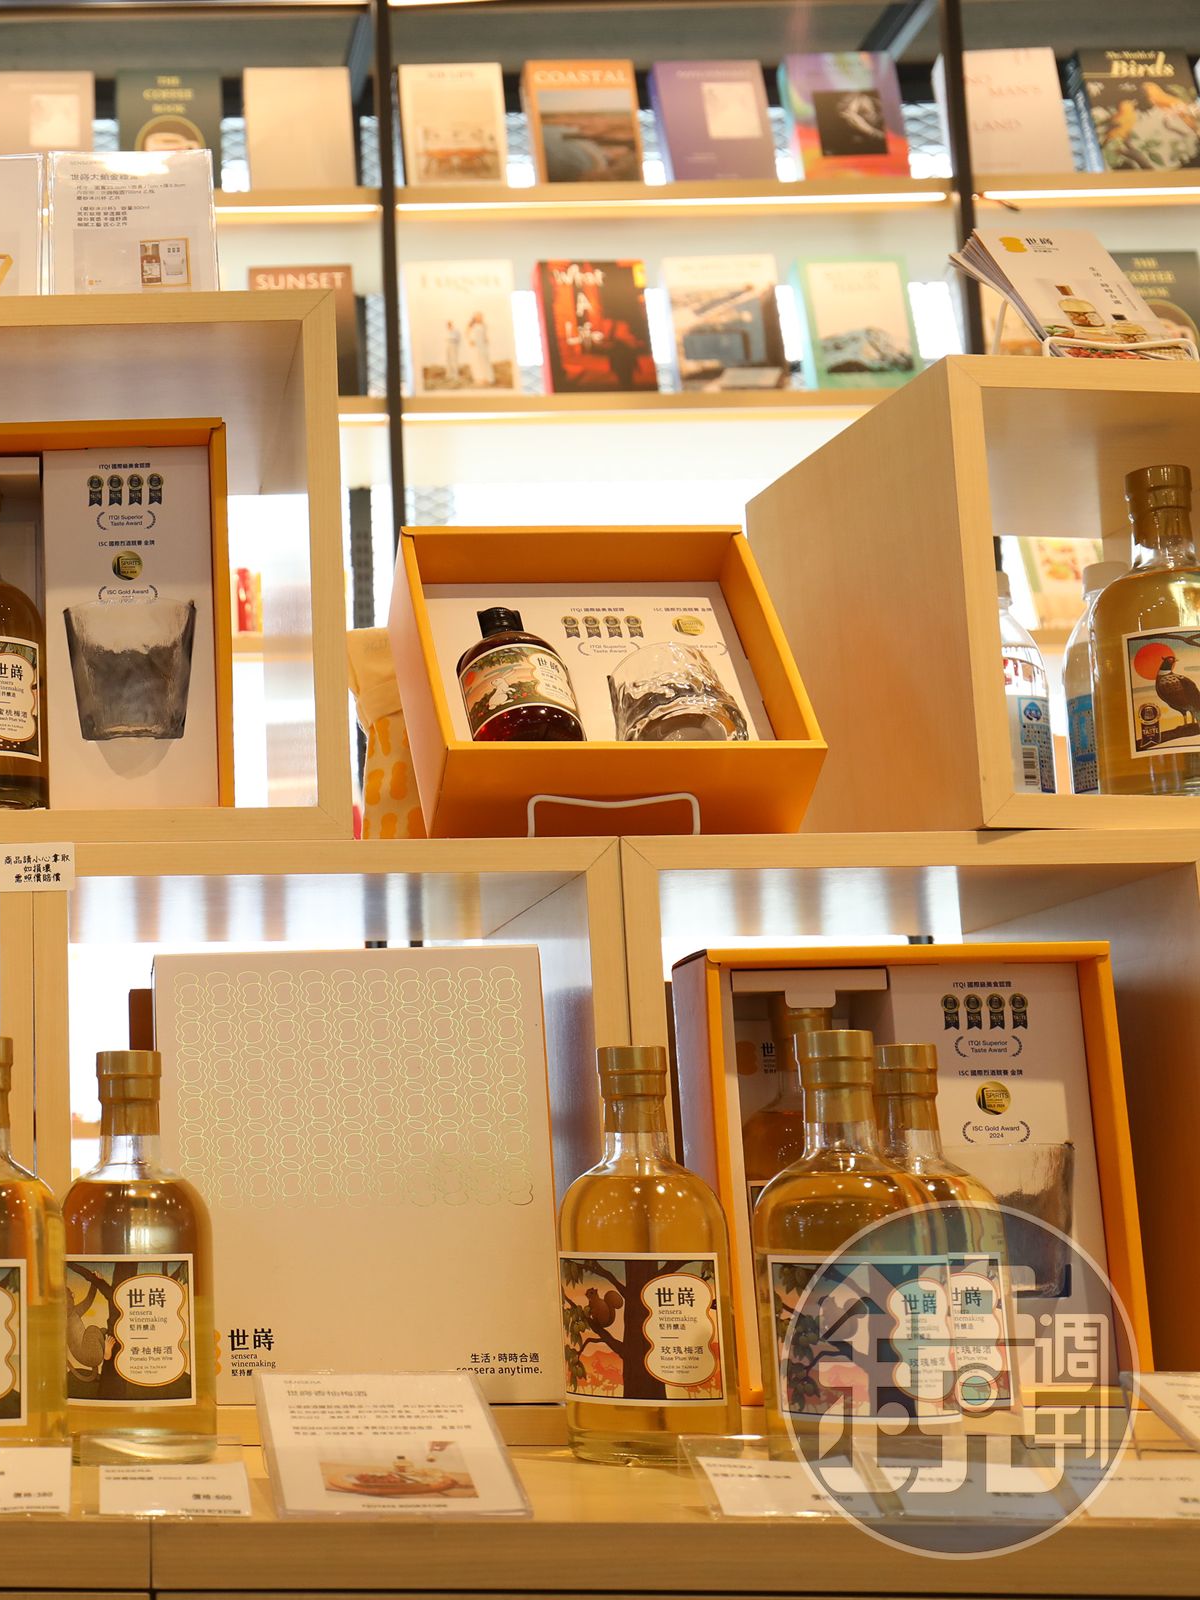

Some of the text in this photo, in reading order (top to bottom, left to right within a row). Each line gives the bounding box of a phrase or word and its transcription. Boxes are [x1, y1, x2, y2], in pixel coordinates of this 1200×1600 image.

[1110, 52, 1174, 77] Birds
[533, 70, 627, 83] COASTAL
[255, 271, 345, 290] SUNSET
[553, 265, 605, 286] What
[577, 292, 592, 317] A
[565, 320, 604, 349] Life
[232, 1360, 276, 1369] winemaking
[498, 1365, 543, 1376] anytime.
